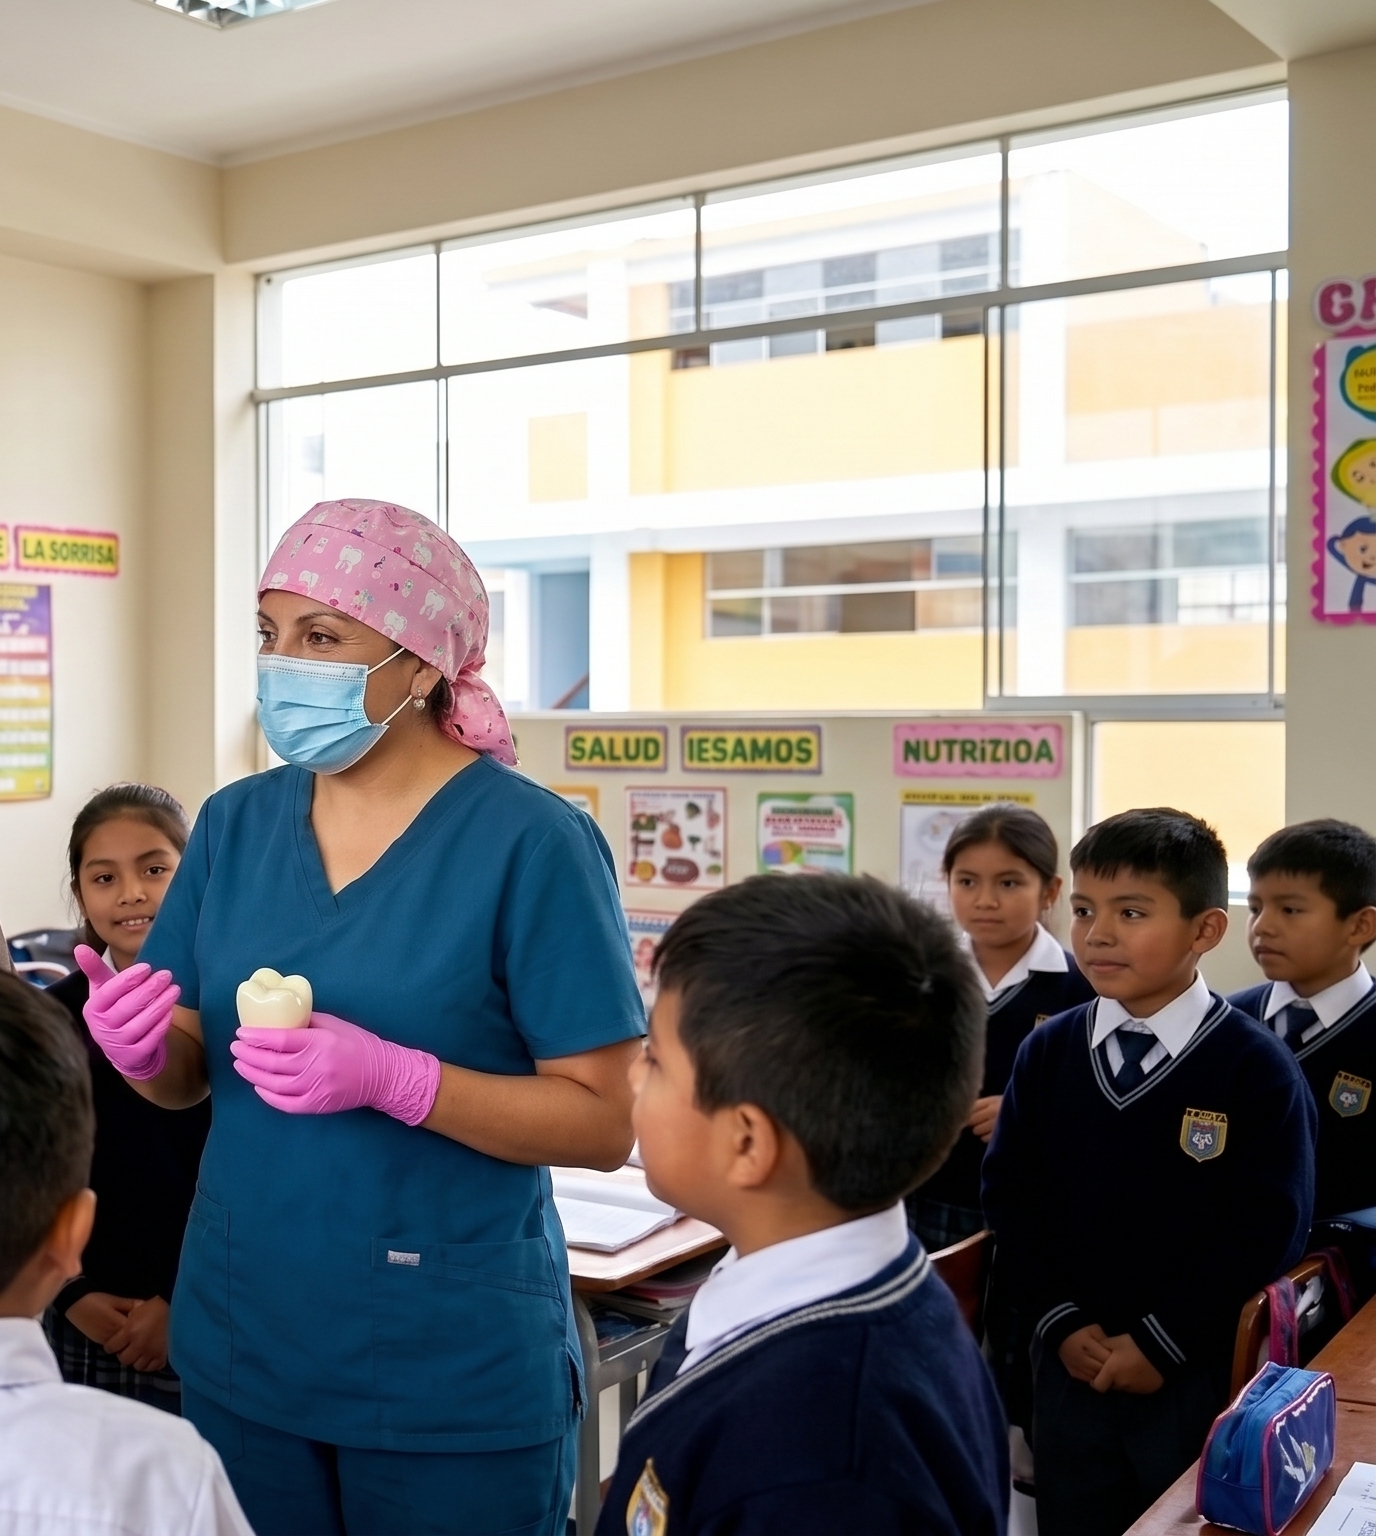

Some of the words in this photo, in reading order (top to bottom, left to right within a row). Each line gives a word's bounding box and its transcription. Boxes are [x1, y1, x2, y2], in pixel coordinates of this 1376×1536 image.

[23, 538, 45, 560] LA
[570, 736, 661, 762] SALUD
[687, 737, 813, 764] IESAMOS
